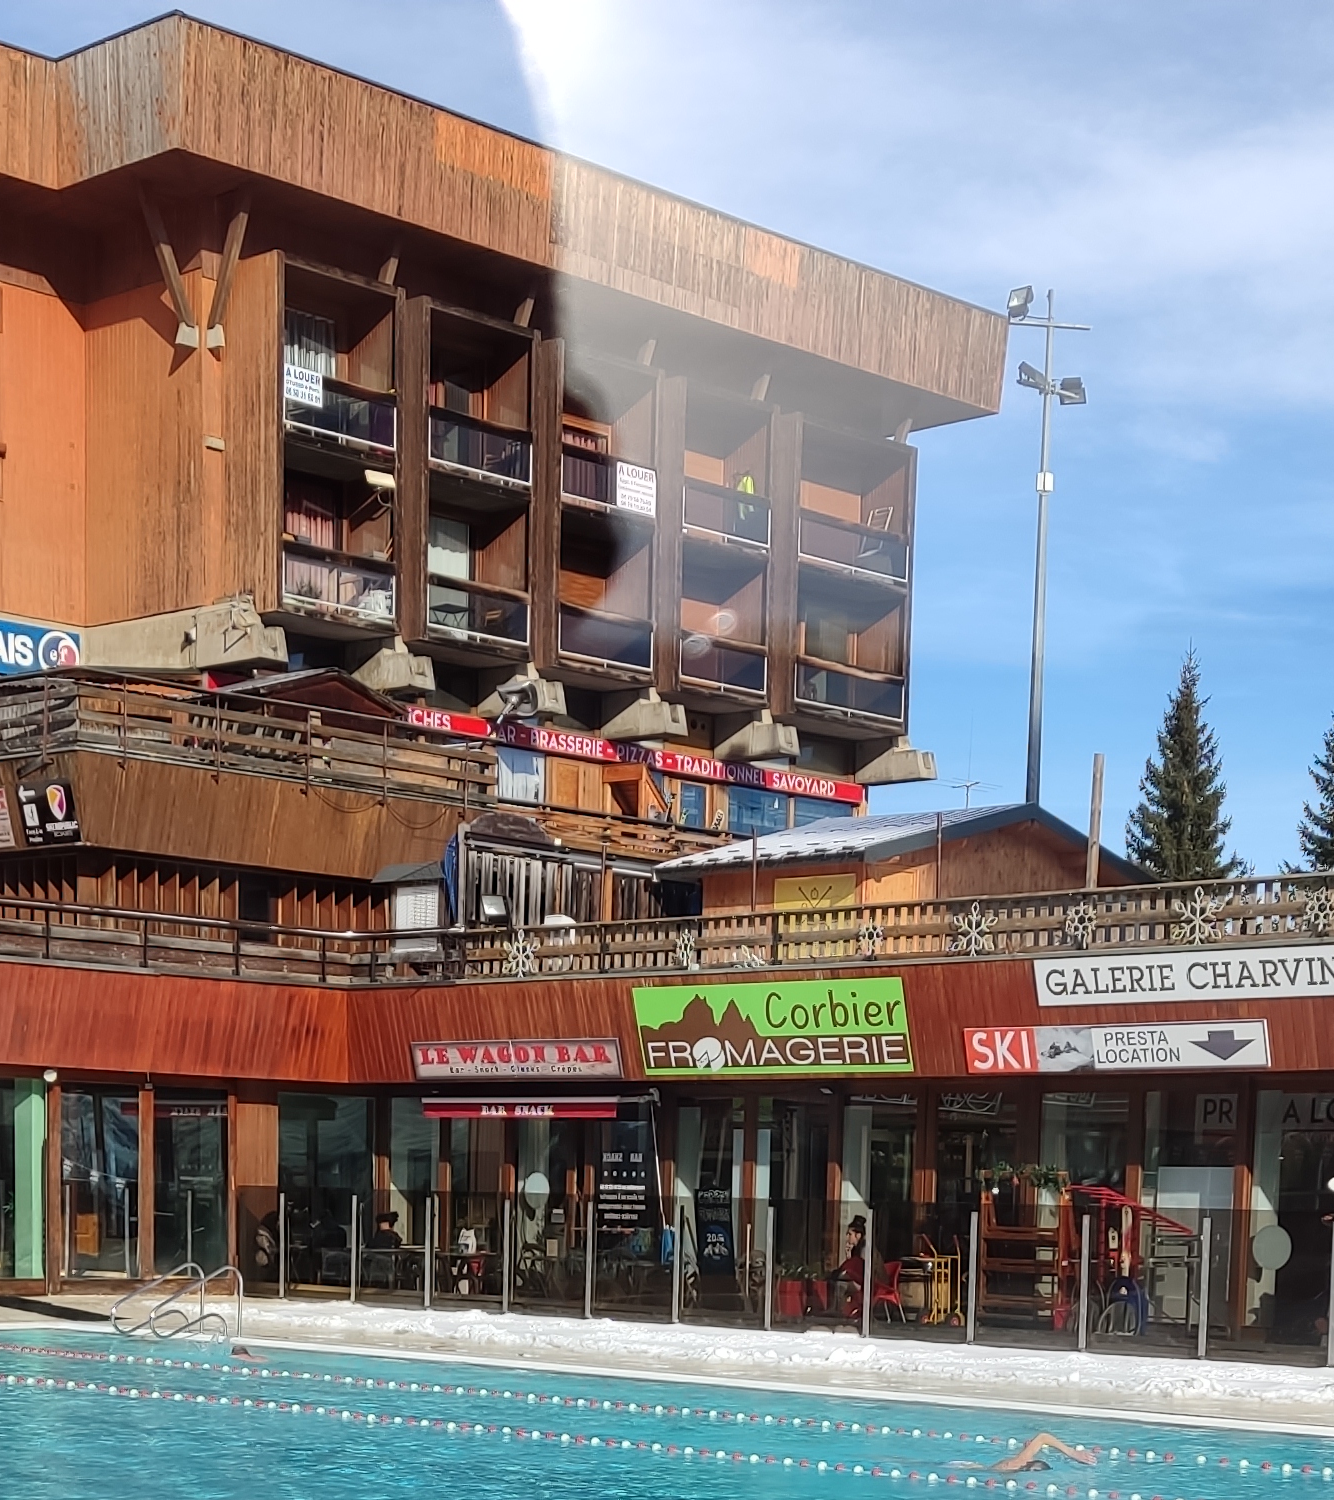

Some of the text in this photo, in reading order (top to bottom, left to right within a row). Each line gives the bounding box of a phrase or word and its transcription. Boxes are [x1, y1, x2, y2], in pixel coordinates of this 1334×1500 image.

[294, 369, 321, 386] LOUER
[627, 467, 654, 483] LOUER
[530, 728, 604, 758] BRASSERIE
[675, 753, 766, 787] TRADITIONNEL
[772, 772, 836, 797] SAVOYARD
[1045, 963, 1176, 996] GALERIE
[765, 991, 902, 1030] Corbier
[1103, 1030, 1170, 1047] PRESTA
[418, 1044, 612, 1066] LE WAGON BAR
[971, 1030, 1032, 1070] SKI
[1096, 1047, 1181, 1064] LOCATION
[481, 1104, 554, 1115] BAR SNACK
